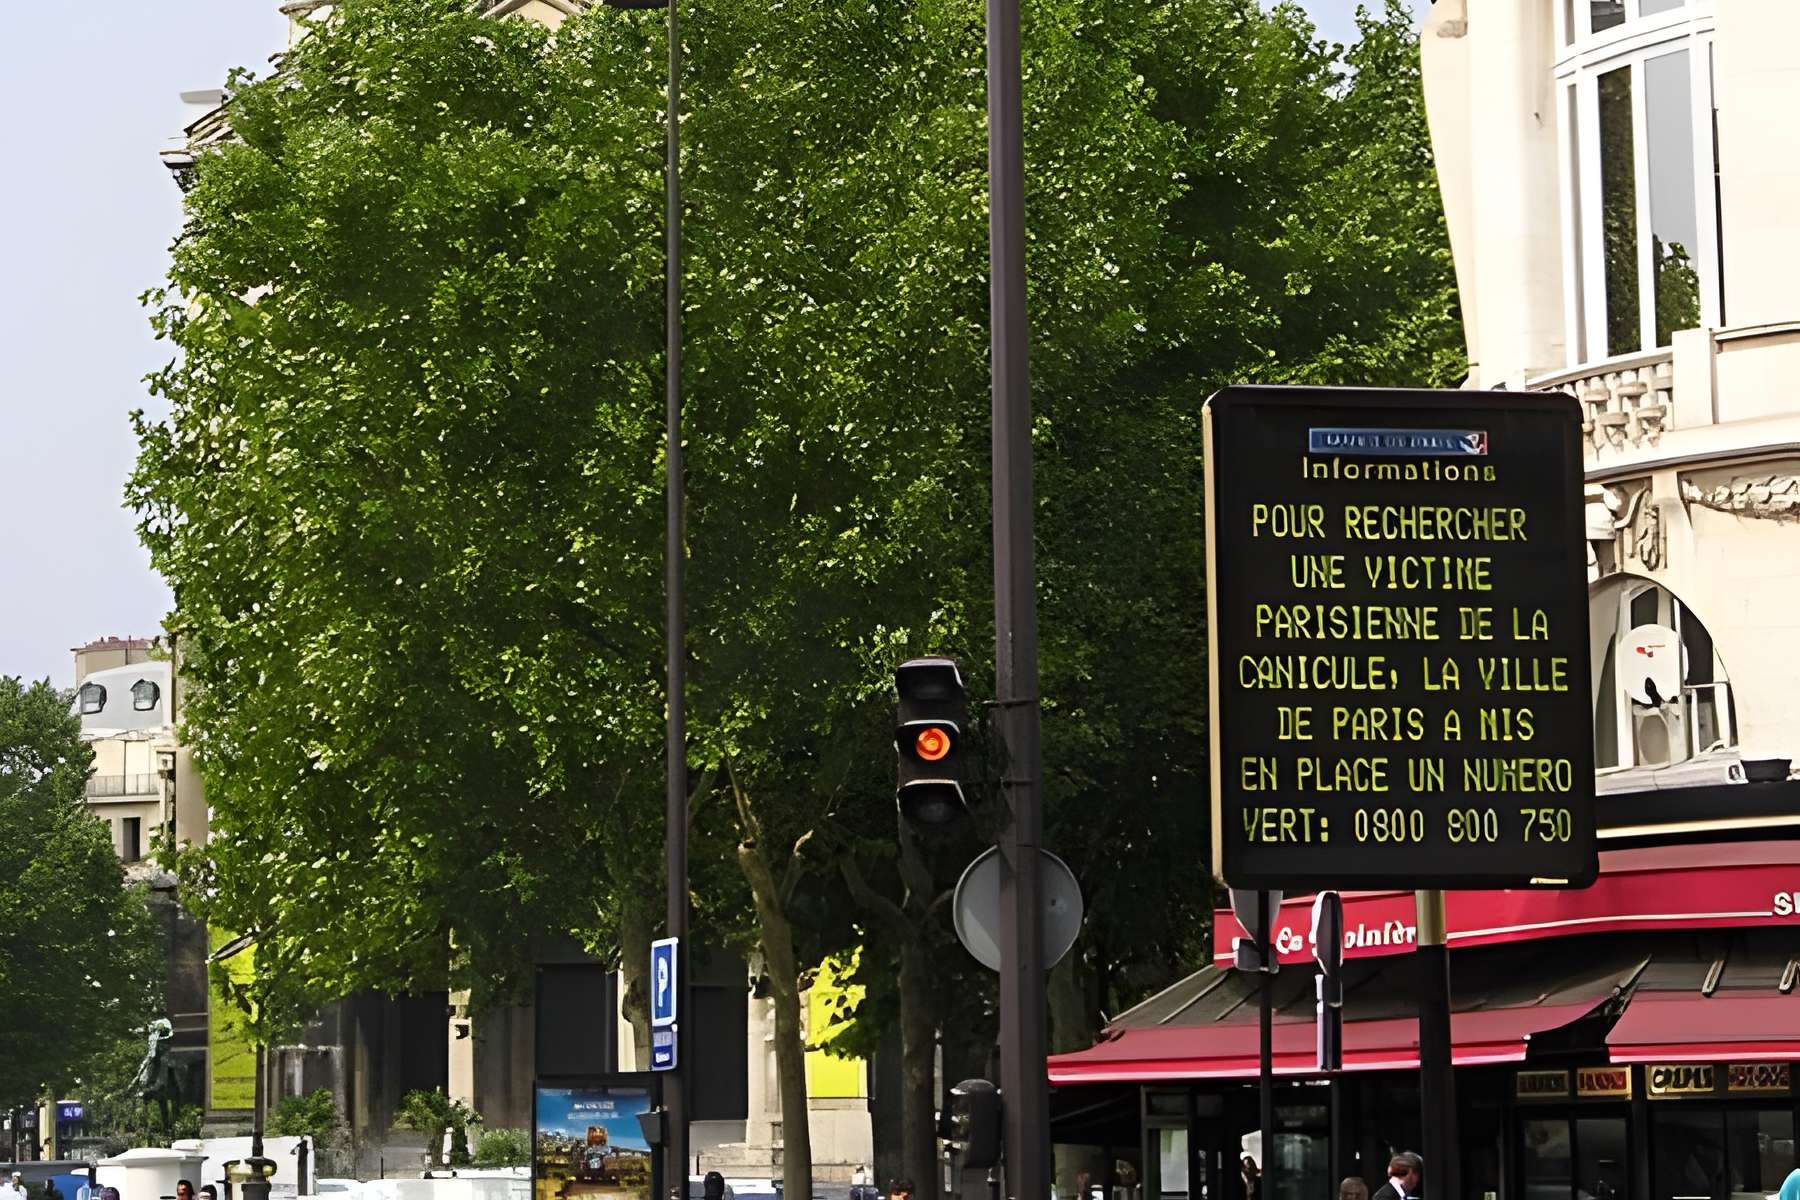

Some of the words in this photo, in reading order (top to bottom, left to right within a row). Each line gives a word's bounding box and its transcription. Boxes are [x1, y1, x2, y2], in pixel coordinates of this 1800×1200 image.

[1303, 456, 1496, 482] Informations
[1253, 504, 1326, 539] POUR
[1345, 506, 1528, 542] RECHERCHER
[1291, 555, 1346, 589] UNE
[1256, 604, 1440, 641] PARISIENNE
[1459, 607, 1494, 641] DE
[1513, 608, 1549, 641] LA
[1424, 657, 1461, 691] LA
[1478, 657, 1569, 692] VILLE
[1278, 707, 1314, 741] DE
[1333, 707, 1425, 742] PARIS
[1444, 709, 1462, 742] A
[1242, 757, 1278, 791] EN
[1298, 757, 1389, 792] PLACE
[1409, 758, 1445, 793] UN
[1464, 758, 1572, 793] NUMERO
[1244, 808, 1329, 843] VERT:
[1355, 808, 1424, 843] 0800
[1448, 808, 1499, 843] 800
[1520, 809, 1572, 843] 750
[658, 957, 669, 1008] P
